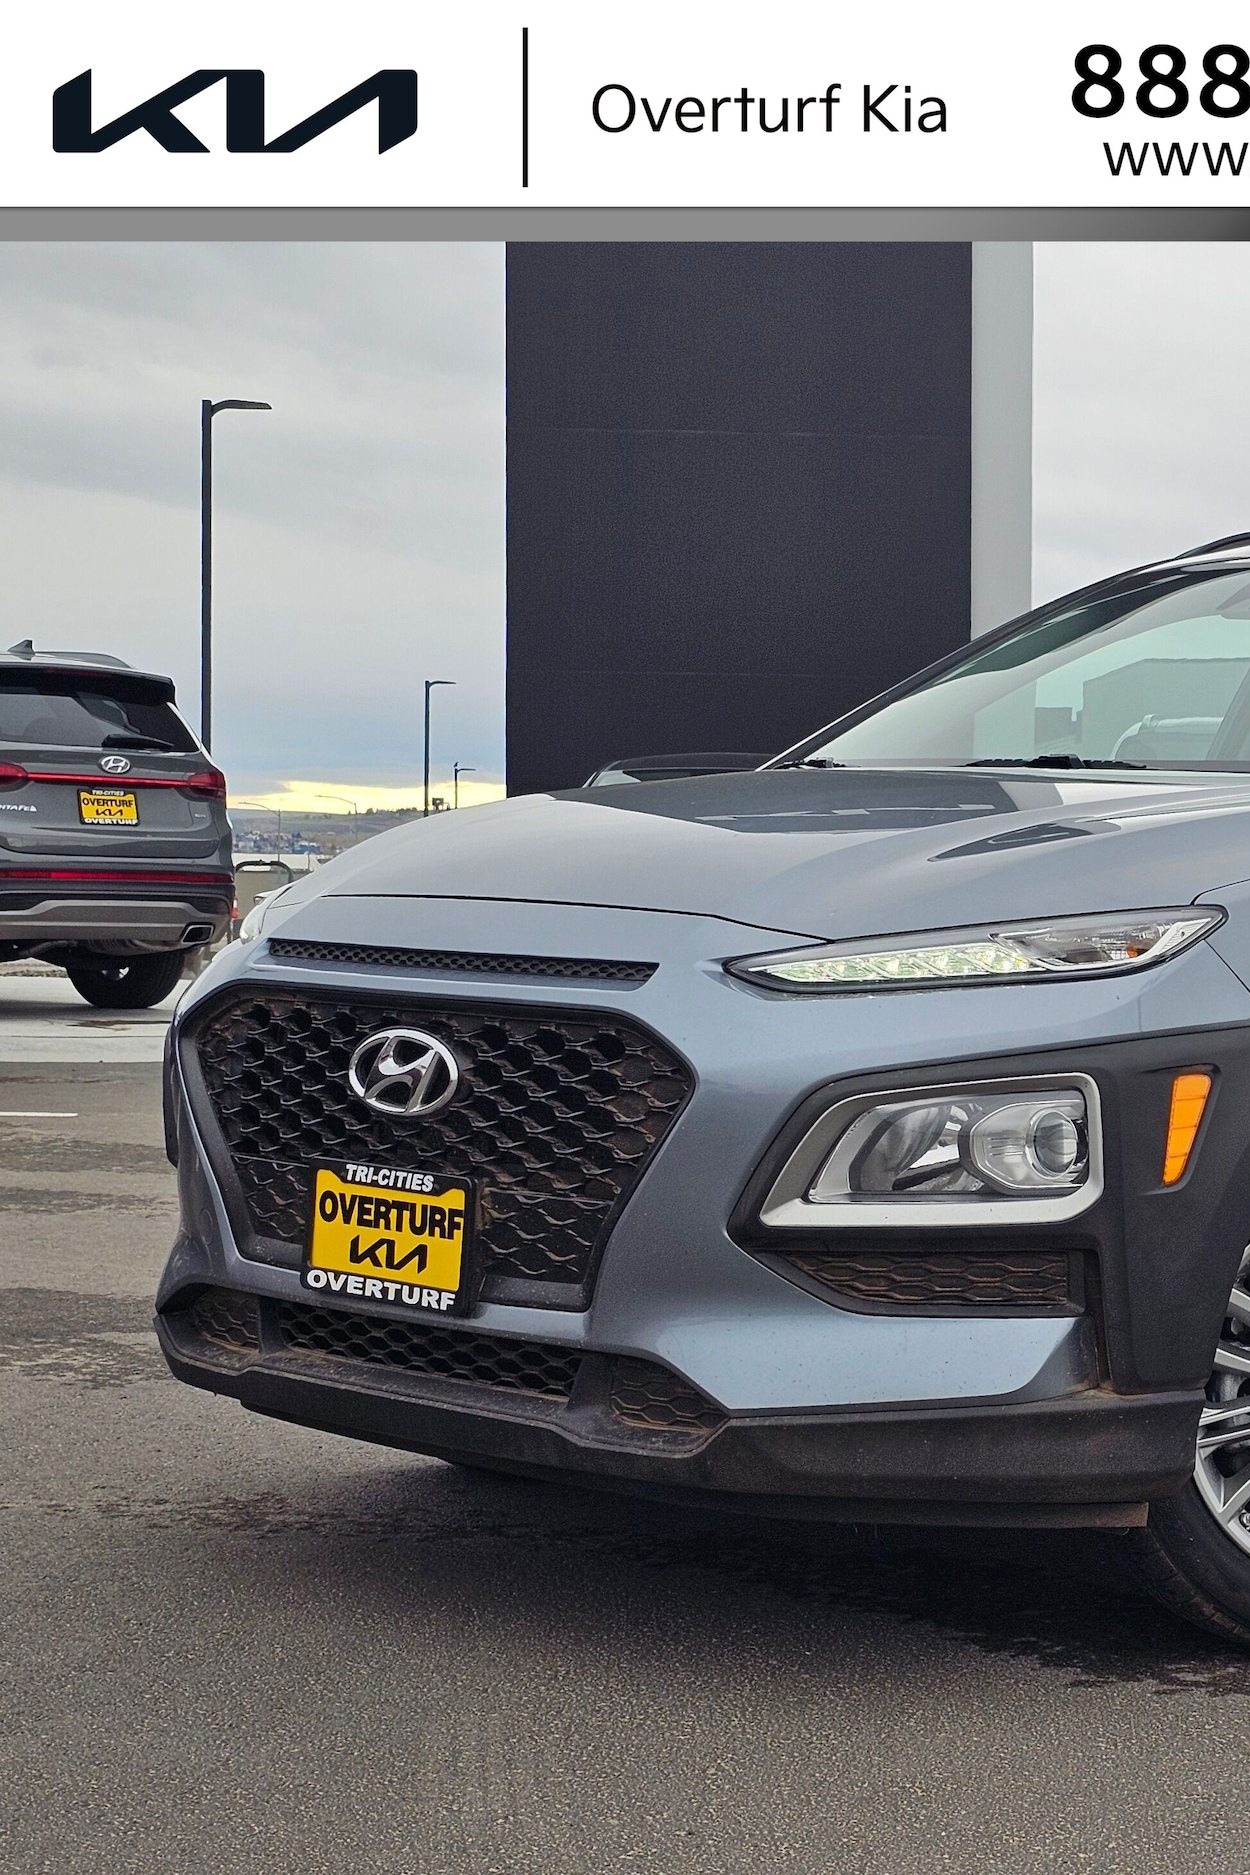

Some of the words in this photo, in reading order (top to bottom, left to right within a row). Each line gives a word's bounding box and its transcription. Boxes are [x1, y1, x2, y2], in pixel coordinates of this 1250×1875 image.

[82, 797, 134, 807] OVERTURF
[346, 1163, 434, 1193] TRI-CITIES
[319, 1190, 464, 1240] OVERTURF
[350, 1234, 428, 1274] KIA
[306, 1269, 456, 1311] OVERTURF
